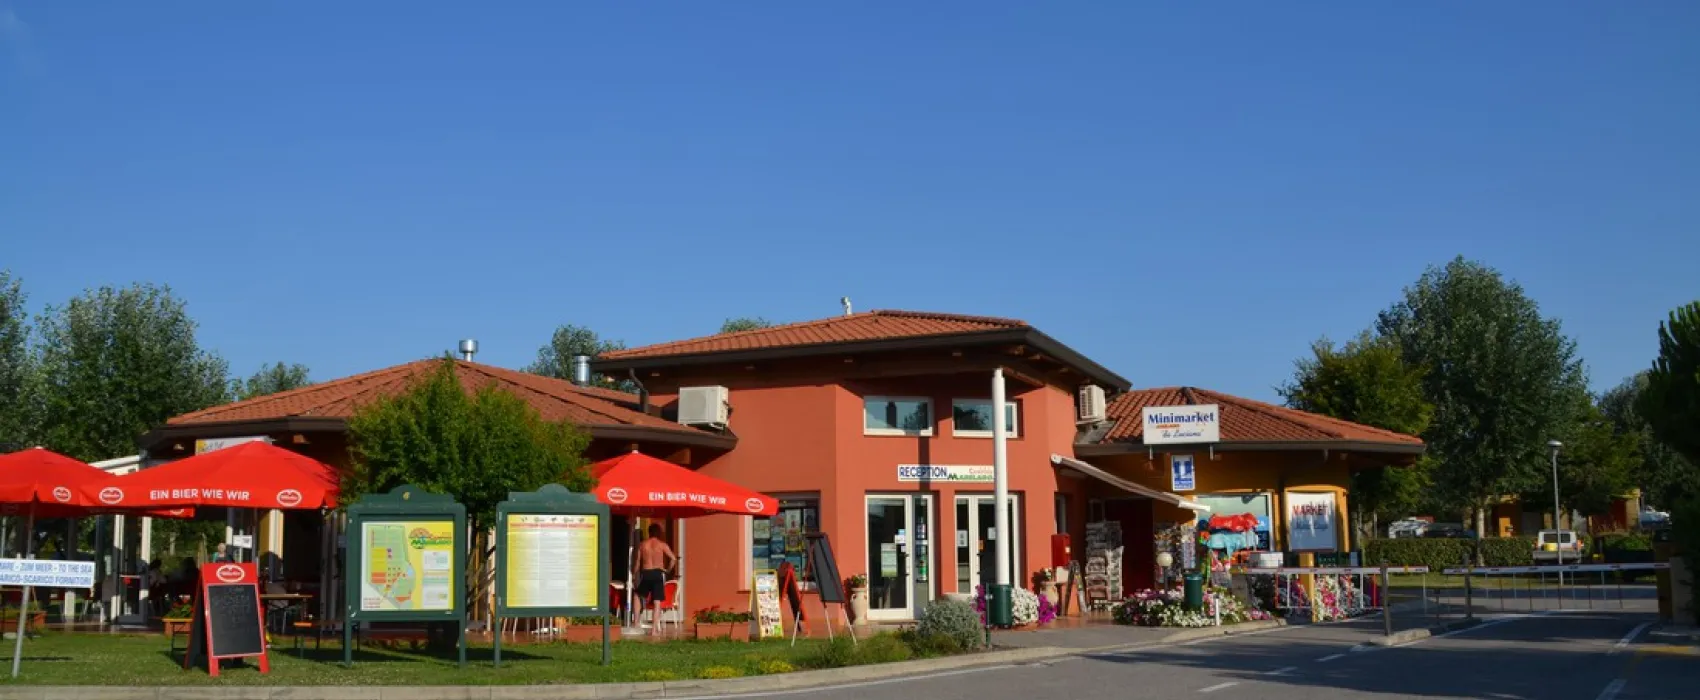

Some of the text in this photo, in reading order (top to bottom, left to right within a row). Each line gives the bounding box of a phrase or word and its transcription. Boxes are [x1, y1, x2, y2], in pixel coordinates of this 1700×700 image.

[1148, 411, 1214, 424] Minimarket
[900, 466, 947, 477] RECEPTION
[150, 489, 250, 501] EIN BIER WIE WIR
[648, 491, 726, 505] EIN BIER WIE WIR
[1292, 503, 1328, 516] MARKET
